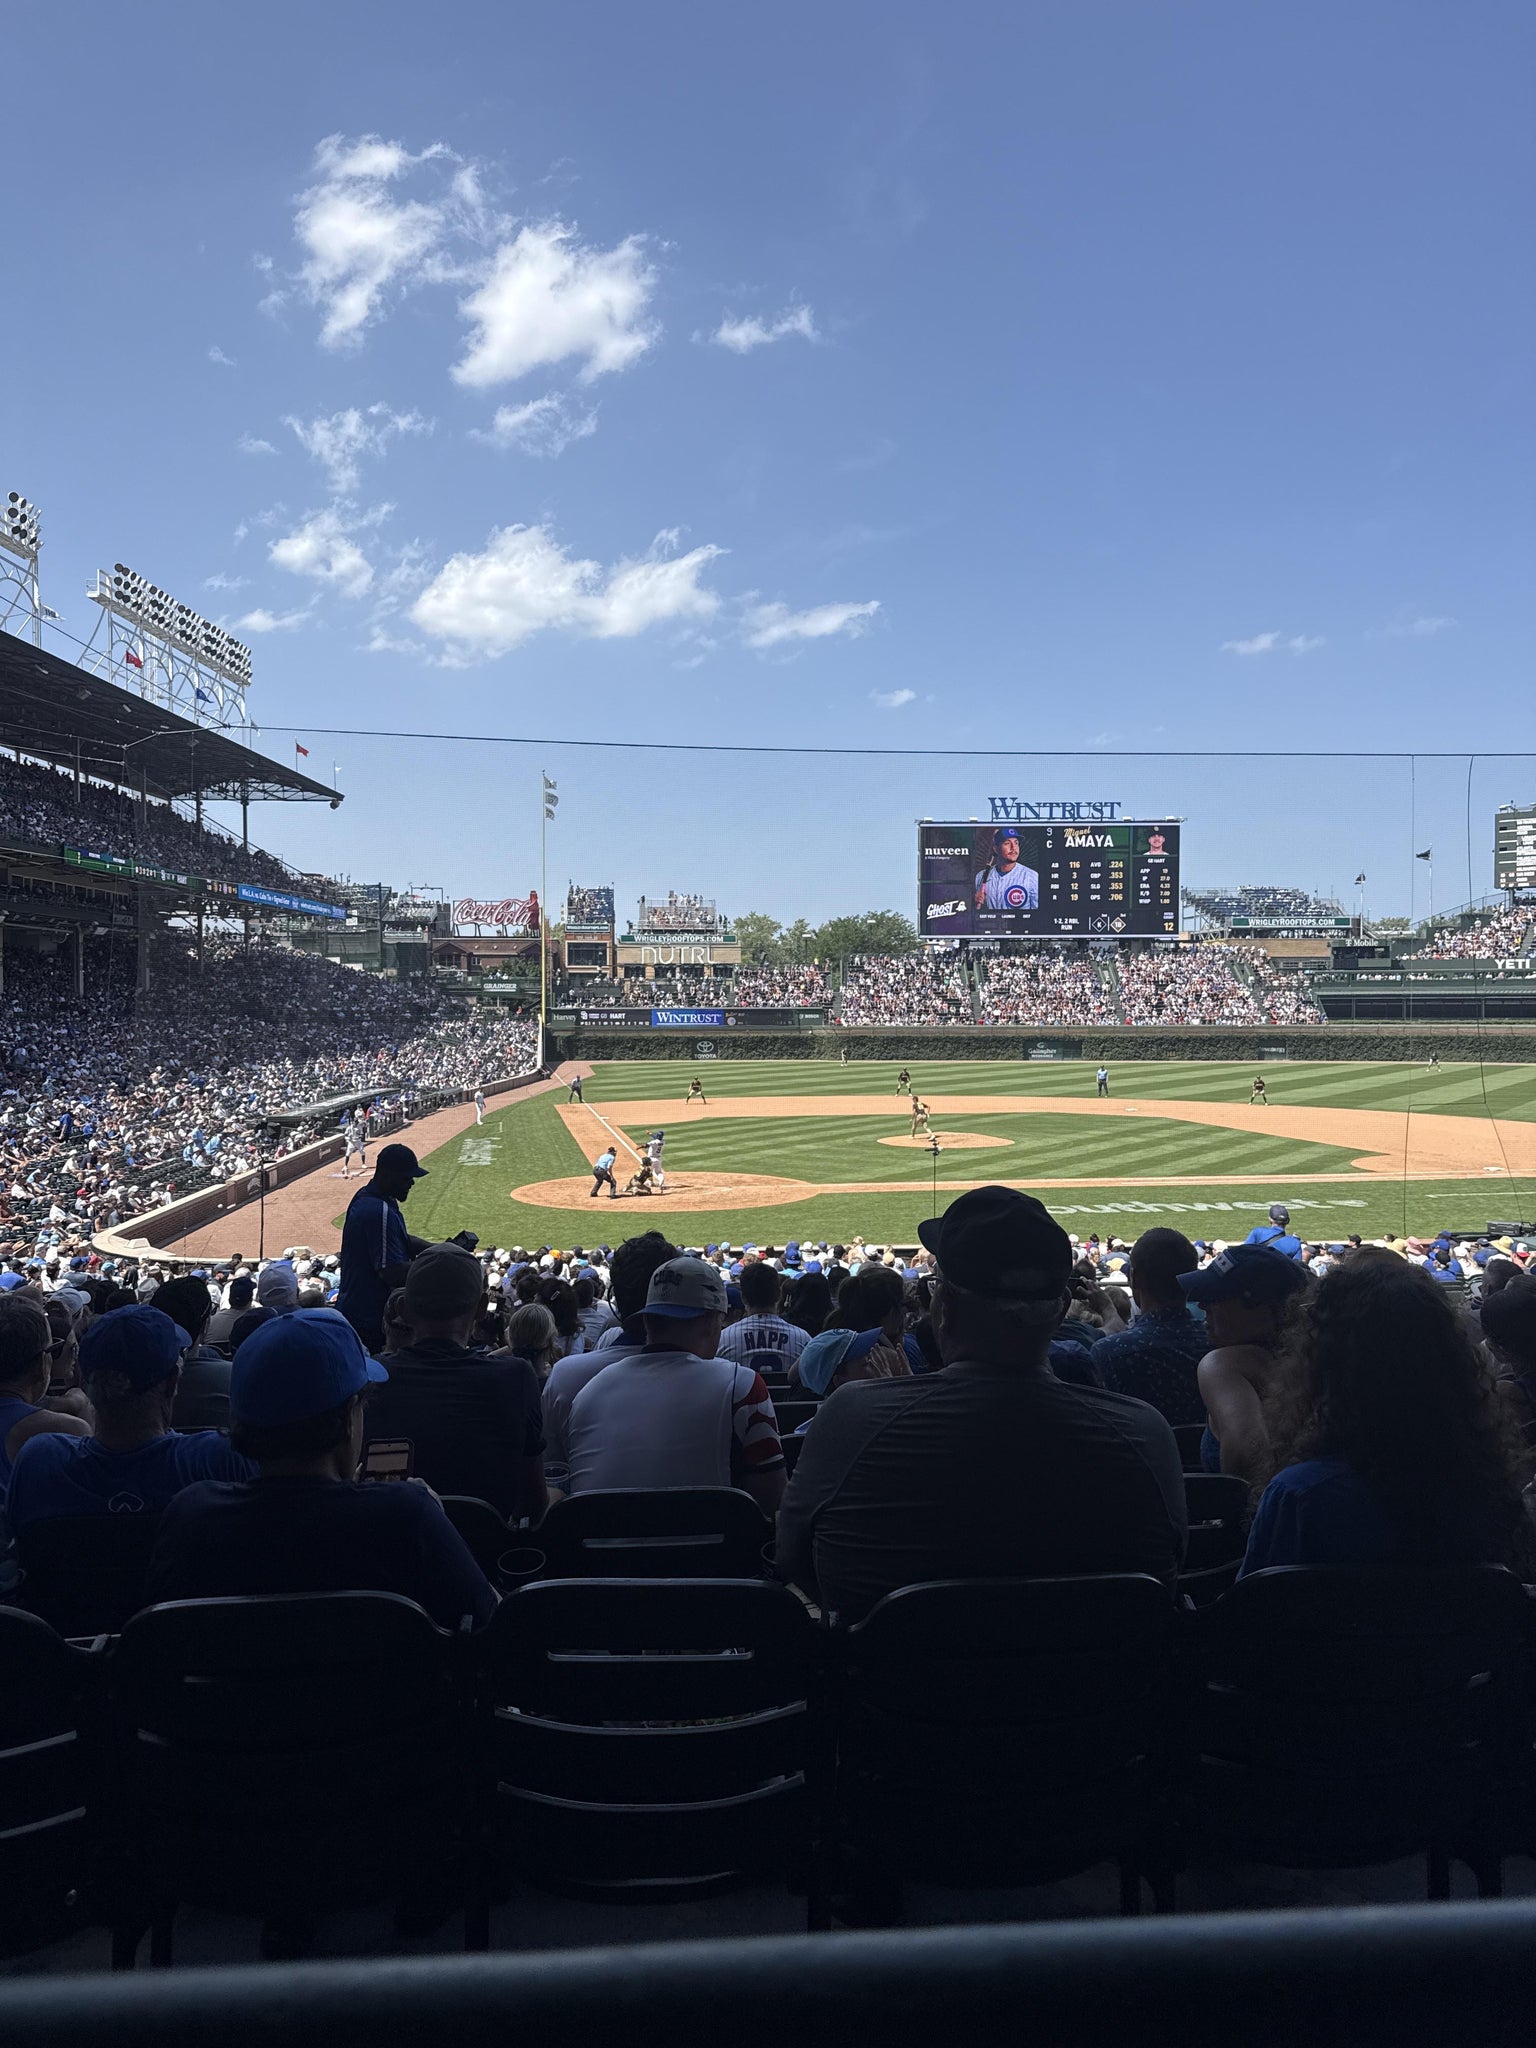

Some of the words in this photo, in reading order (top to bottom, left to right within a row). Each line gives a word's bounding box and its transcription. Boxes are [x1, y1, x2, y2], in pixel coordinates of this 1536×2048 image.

[988, 797, 1121, 820] WINTRUST
[1046, 840, 1053, 848] C
[1065, 835, 1114, 848] AMAYA
[924, 847, 969, 856] nuveen
[1069, 861, 1080, 869] 116
[1072, 871, 1077, 879] 3
[1070, 882, 1079, 890] 12
[453, 898, 534, 927] Coca-Cola
[926, 901, 958, 918] GHOST
[1163, 922, 1174, 931] 12
[1248, 918, 1335, 926] WRIGLEYROOFTOPS.COM
[1353, 939, 1379, 947] Mobile
[1494, 959, 1530, 969] YETI
[553, 1013, 577, 1022] Harvey
[656, 1011, 720, 1023] WINTRUST
[1045, 1199, 1334, 1214] outhwest
[743, 1328, 789, 1351] HAPP
